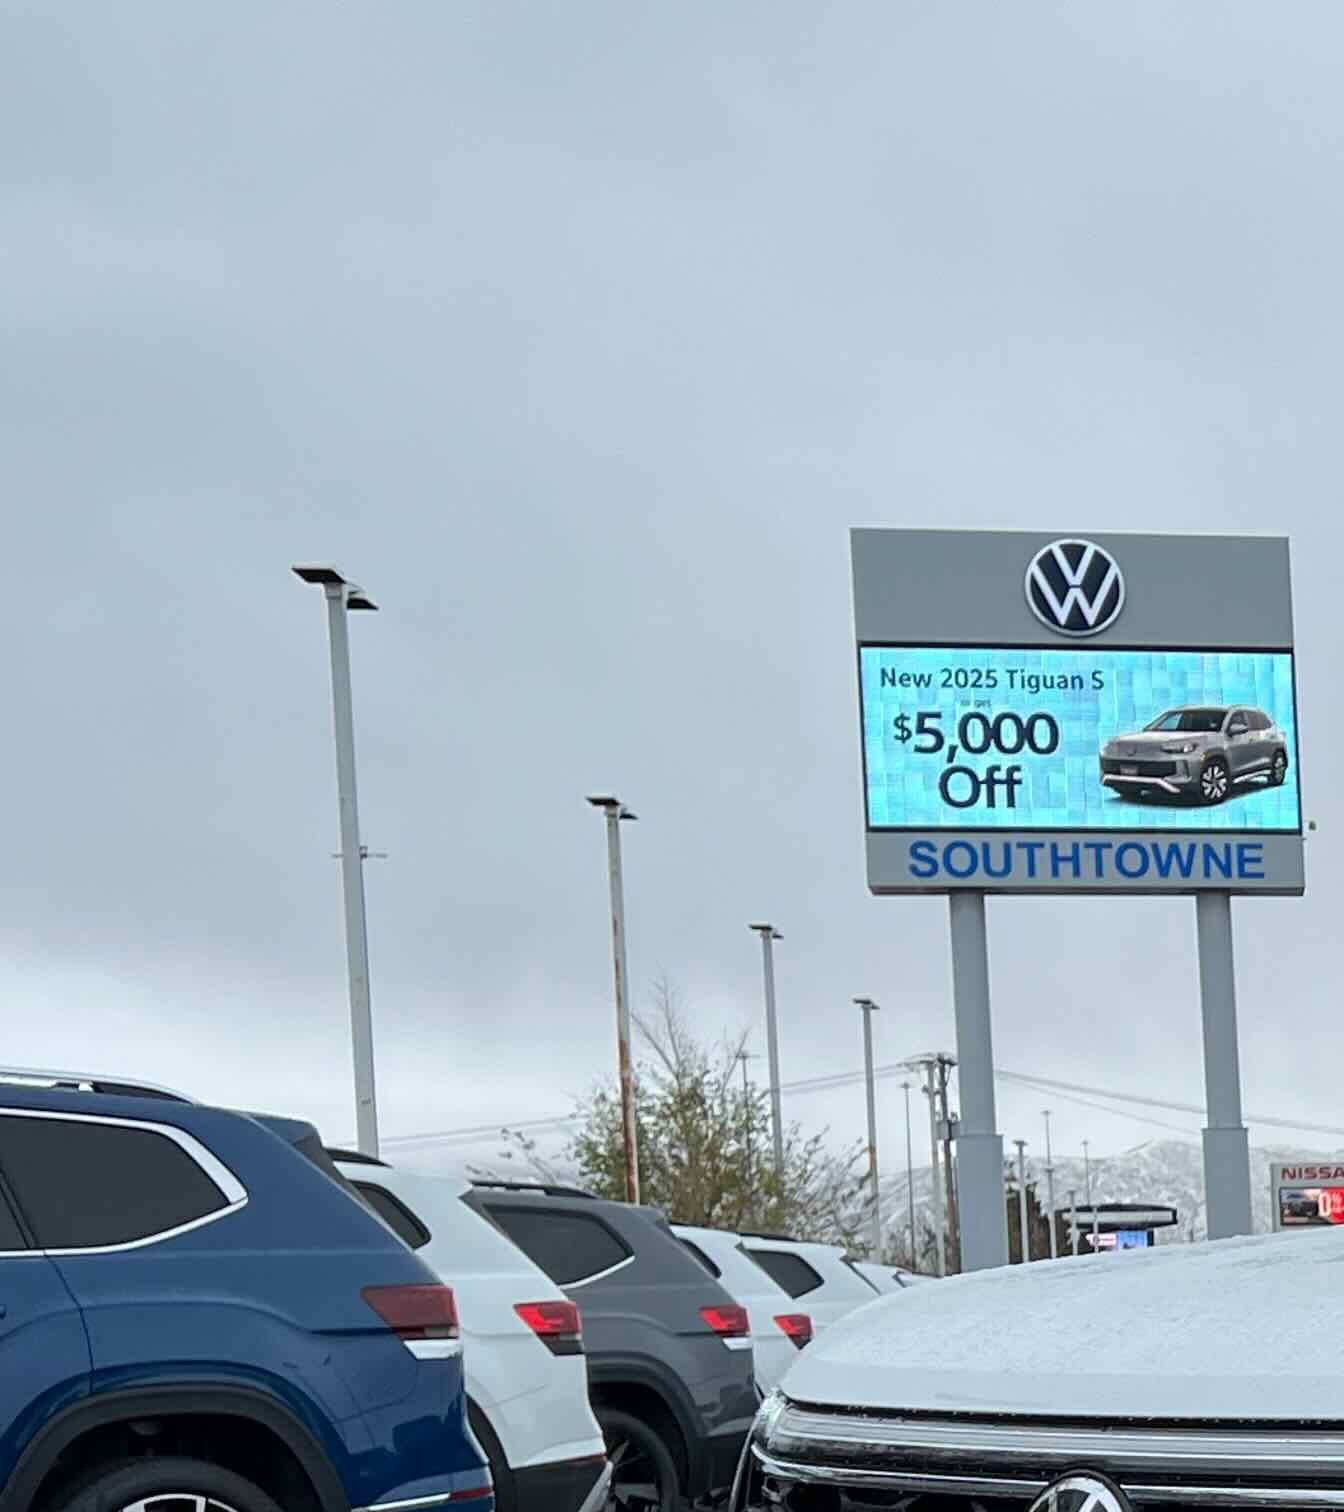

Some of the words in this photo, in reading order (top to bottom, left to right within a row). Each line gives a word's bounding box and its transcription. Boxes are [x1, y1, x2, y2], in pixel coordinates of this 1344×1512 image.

[1031, 543, 1119, 628] VW
[881, 668, 932, 688] New
[940, 668, 998, 688] 2025
[1005, 669, 1084, 694] Tiguan
[1092, 670, 1104, 689] S
[893, 711, 1060, 764] $5,000
[939, 764, 1023, 809] Off
[909, 841, 1264, 879] SOUTHTOWNE
